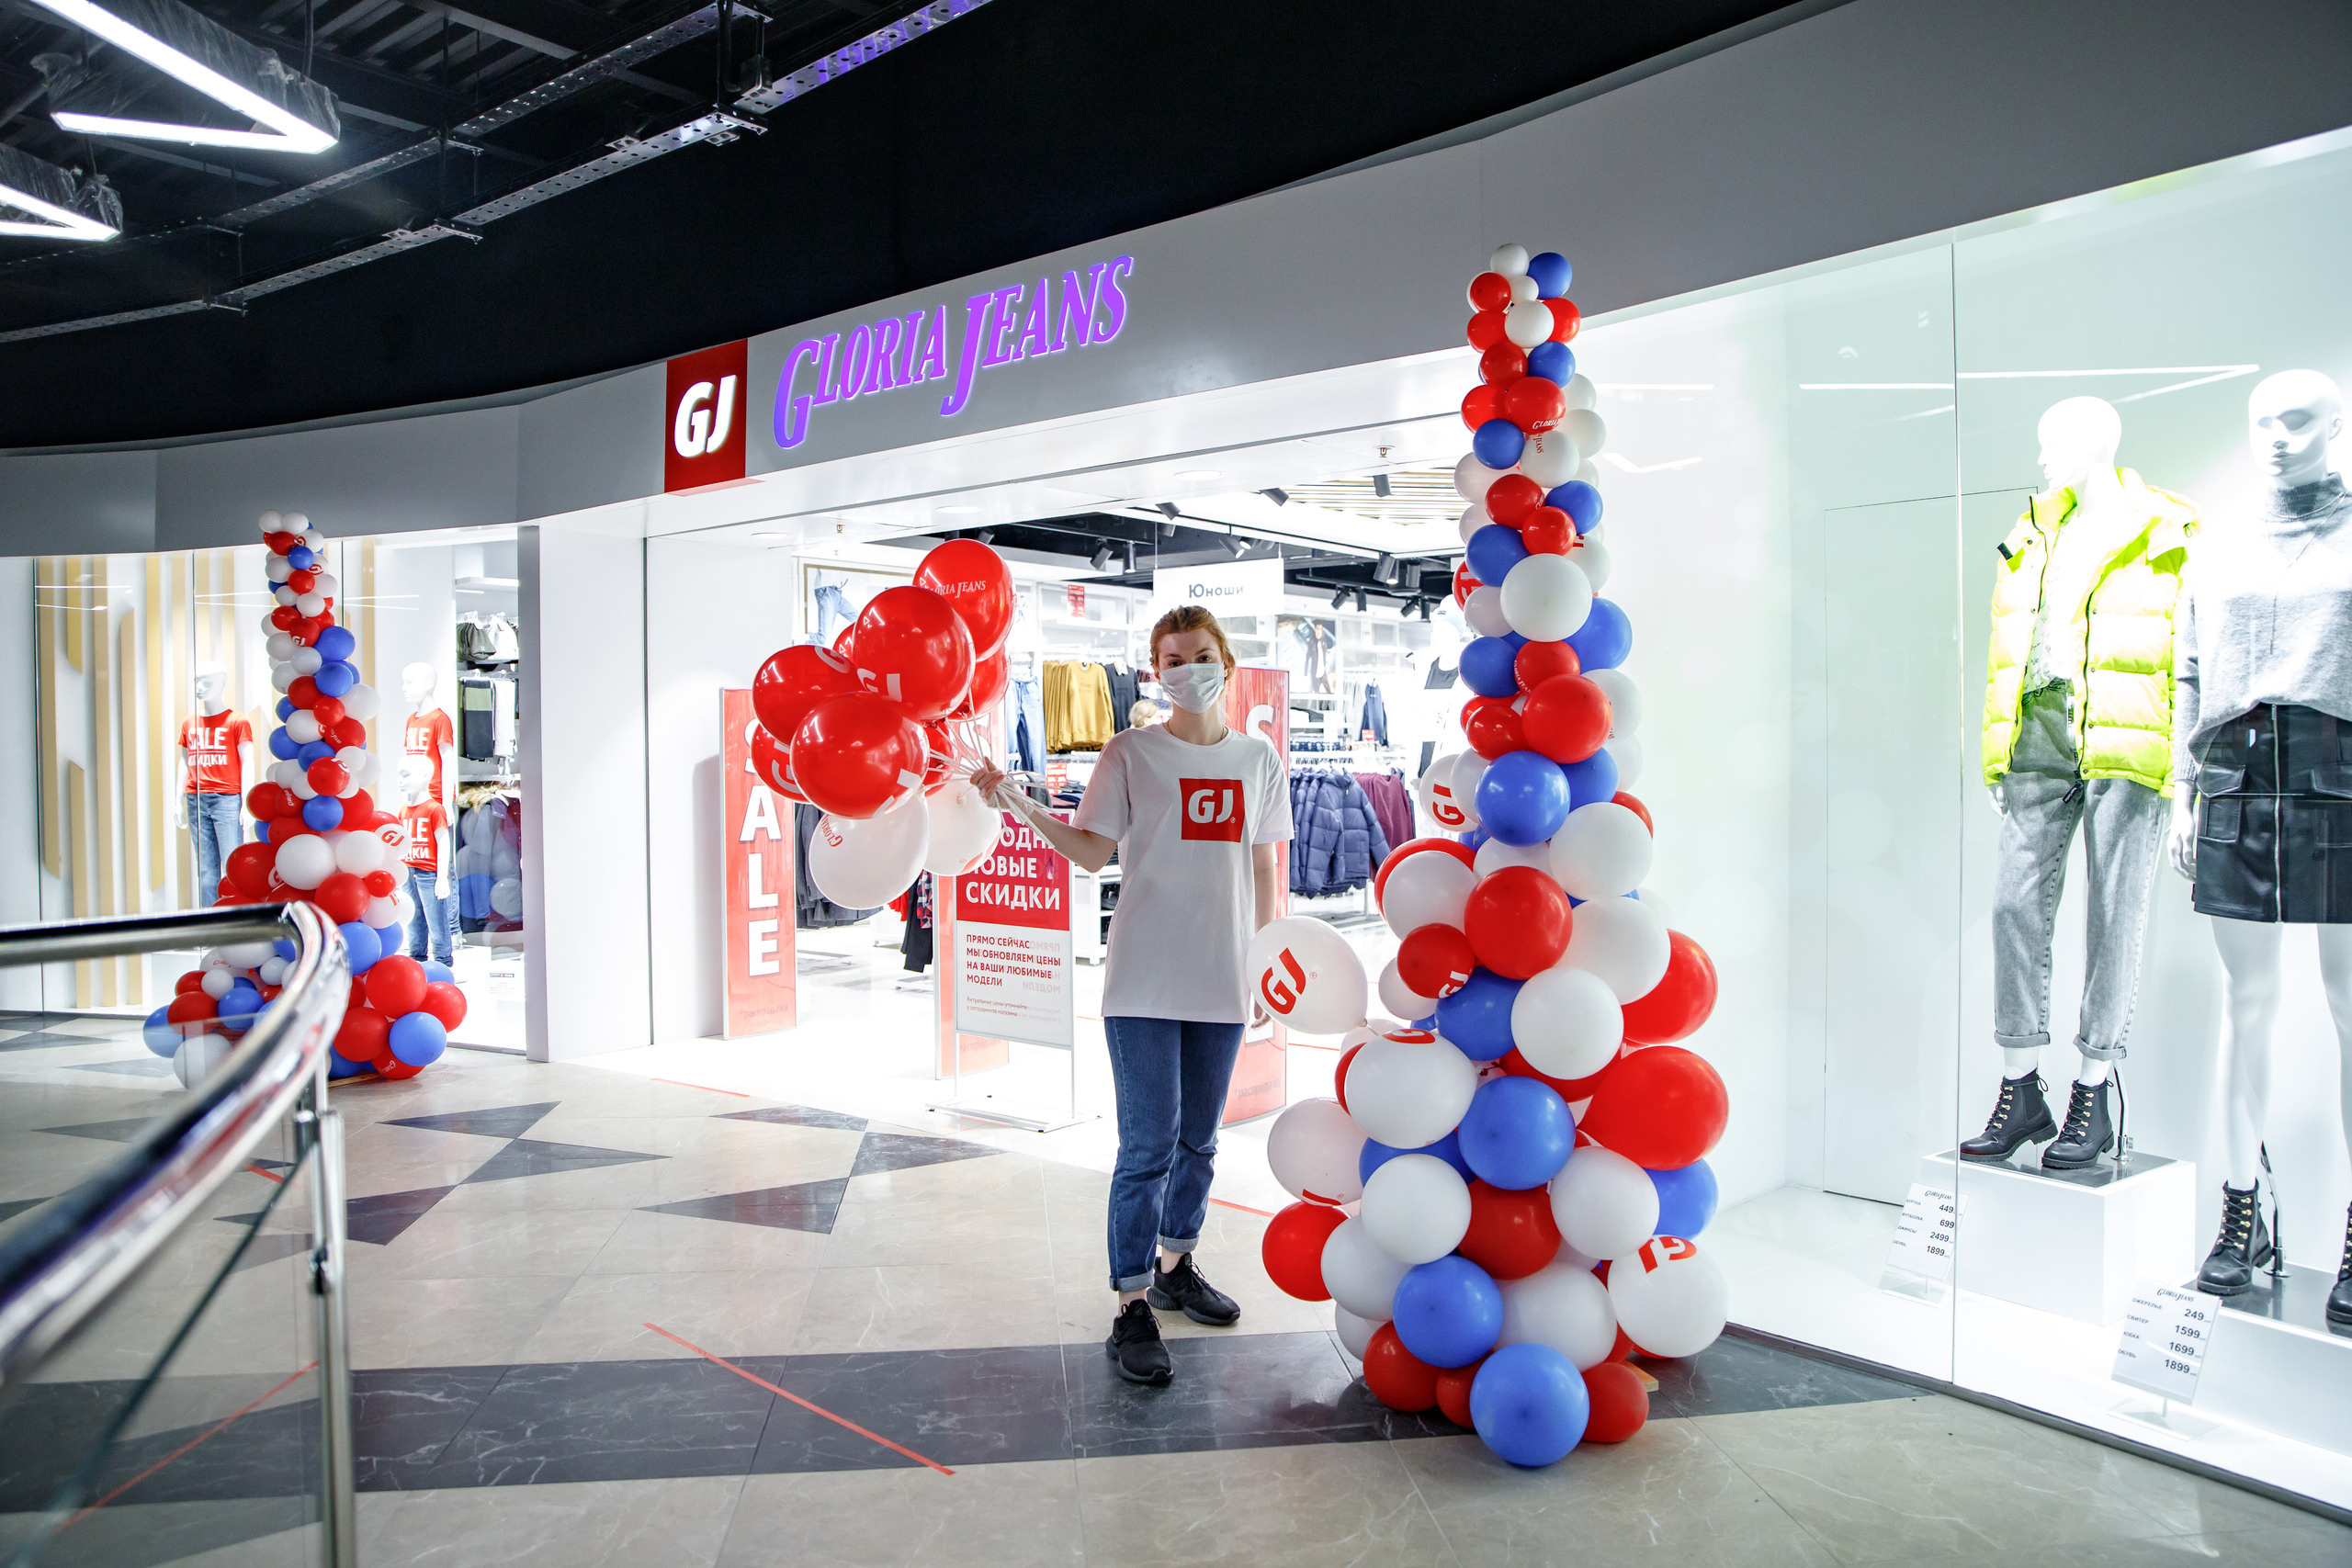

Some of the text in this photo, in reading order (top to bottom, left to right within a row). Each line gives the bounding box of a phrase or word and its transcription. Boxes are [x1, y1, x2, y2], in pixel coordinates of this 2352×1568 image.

[773, 255, 1135, 449] GLORIA JEANS
[674, 374, 737, 457] GJ
[955, 581, 986, 598] JEANS
[1189, 583, 1243, 598] Юноши
[1188, 789, 1235, 824] GJ
[381, 830, 404, 846] GJ
[966, 882, 1060, 910] СКИДКИ
[967, 934, 1030, 949] ПРЯМО СЕЙЧАС
[967, 948, 1061, 966] МЫ ОБНОВЛЯЕМ ЦЕНЫ
[967, 961, 1052, 979] НА ВАШИ ЛЮБИМЫЕ
[967, 975, 1002, 987] МОДЕЛИ
[1261, 947, 1306, 1014] GJ
[1939, 1219, 1955, 1229] 699
[1930, 1232, 1950, 1242] 2499
[1927, 1246, 1945, 1257] 1899
[2184, 1308, 2204, 1321] 249
[2176, 1325, 2200, 1339] 1599
[2169, 1342, 2195, 1356] 1699
[2165, 1359, 2190, 1373] 1899
